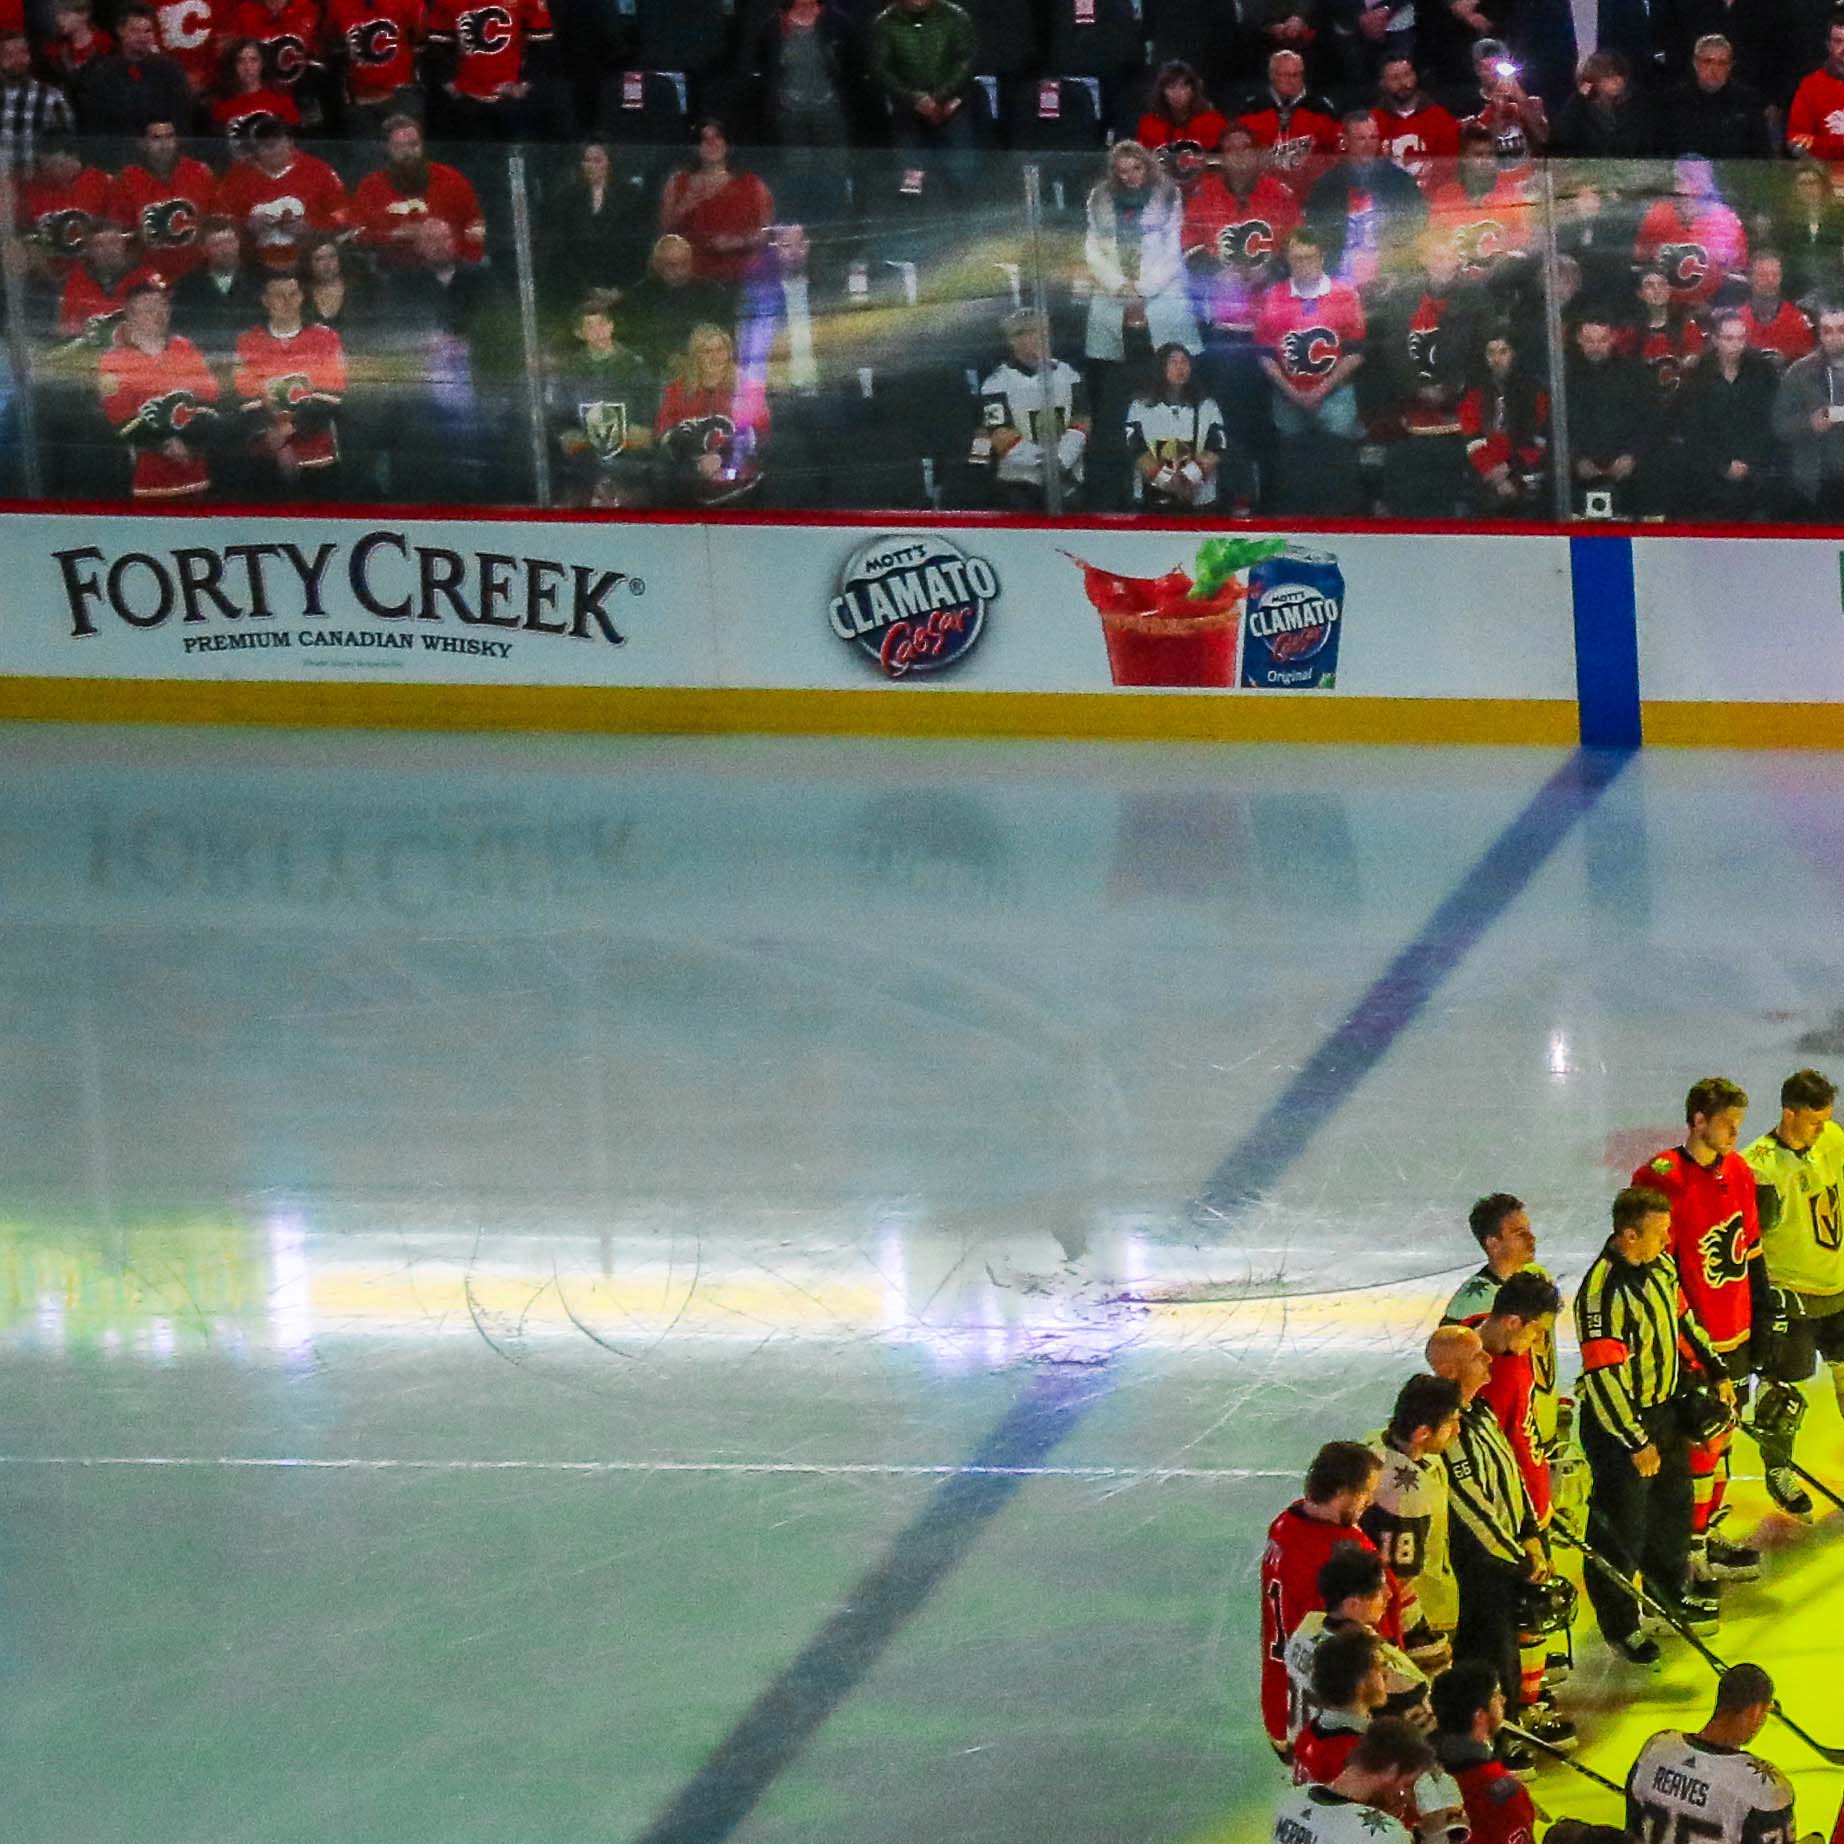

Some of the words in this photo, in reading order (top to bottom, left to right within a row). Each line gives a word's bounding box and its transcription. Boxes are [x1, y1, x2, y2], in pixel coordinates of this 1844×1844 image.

[51, 542, 337, 640] FORTY
[347, 530, 627, 647] CREEK
[828, 556, 998, 641] CLAMATO
[1248, 597, 1340, 639] CLAMATO
[184, 630, 291, 654] PREMIUM
[298, 629, 414, 649] CANADIAN
[423, 636, 514, 659] WHISKY
[1266, 667, 1314, 684] Original
